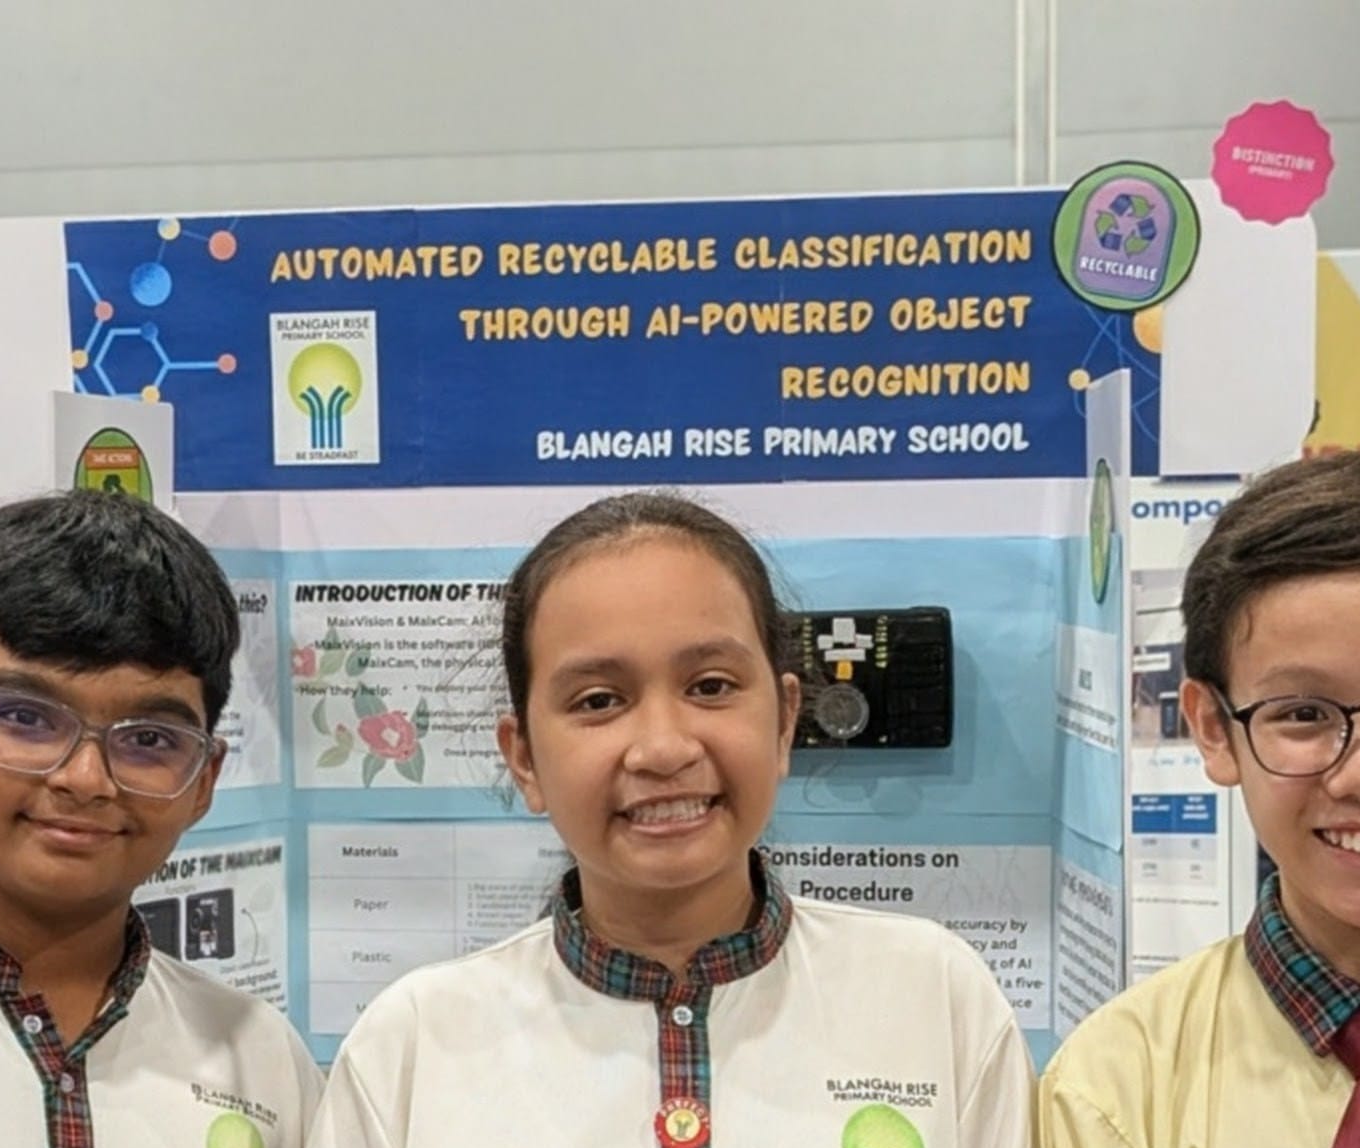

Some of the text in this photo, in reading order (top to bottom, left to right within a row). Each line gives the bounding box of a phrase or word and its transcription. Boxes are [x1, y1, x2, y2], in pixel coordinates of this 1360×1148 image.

[1232, 146, 1316, 172] DISTINCTION
[271, 230, 1032, 283] AUTOMATED RECYCLABLE CLASSIFICATION
[1080, 256, 1158, 281] RECYCLABLE
[276, 317, 369, 330] BLANGAH RISE
[459, 295, 1031, 340] THROUGH AI-POWERED OBJECT
[282, 330, 365, 340] PRIMARY SCHOOL
[781, 361, 1030, 400] RECOGNITION
[537, 422, 1029, 460] BLANGAH RISE PRIMARY SCHOOL
[295, 583, 443, 603] INTRODUCTION
[445, 583, 473, 601] OF
[327, 615, 394, 627] MaixVision
[396, 616, 405, 627] &
[396, 639, 418, 650] the
[420, 639, 474, 651] software
[421, 657, 442, 668] the
[330, 685, 358, 698] they
[342, 846, 399, 858] Materials
[931, 852, 959, 868] on
[180, 858, 198, 880] OF
[200, 853, 224, 876] THE
[800, 880, 913, 902] Procedure
[354, 898, 390, 911] Paper
[944, 917, 1027, 934] accuracy by
[991, 939, 1017, 950] and
[352, 950, 392, 963] Plastic
[1000, 957, 1032, 969] of AI
[1004, 979, 1012, 989] a
[826, 1077, 938, 1097] BLANGAH RISE
[833, 1091, 933, 1108] PRIMARY SCHOOL
